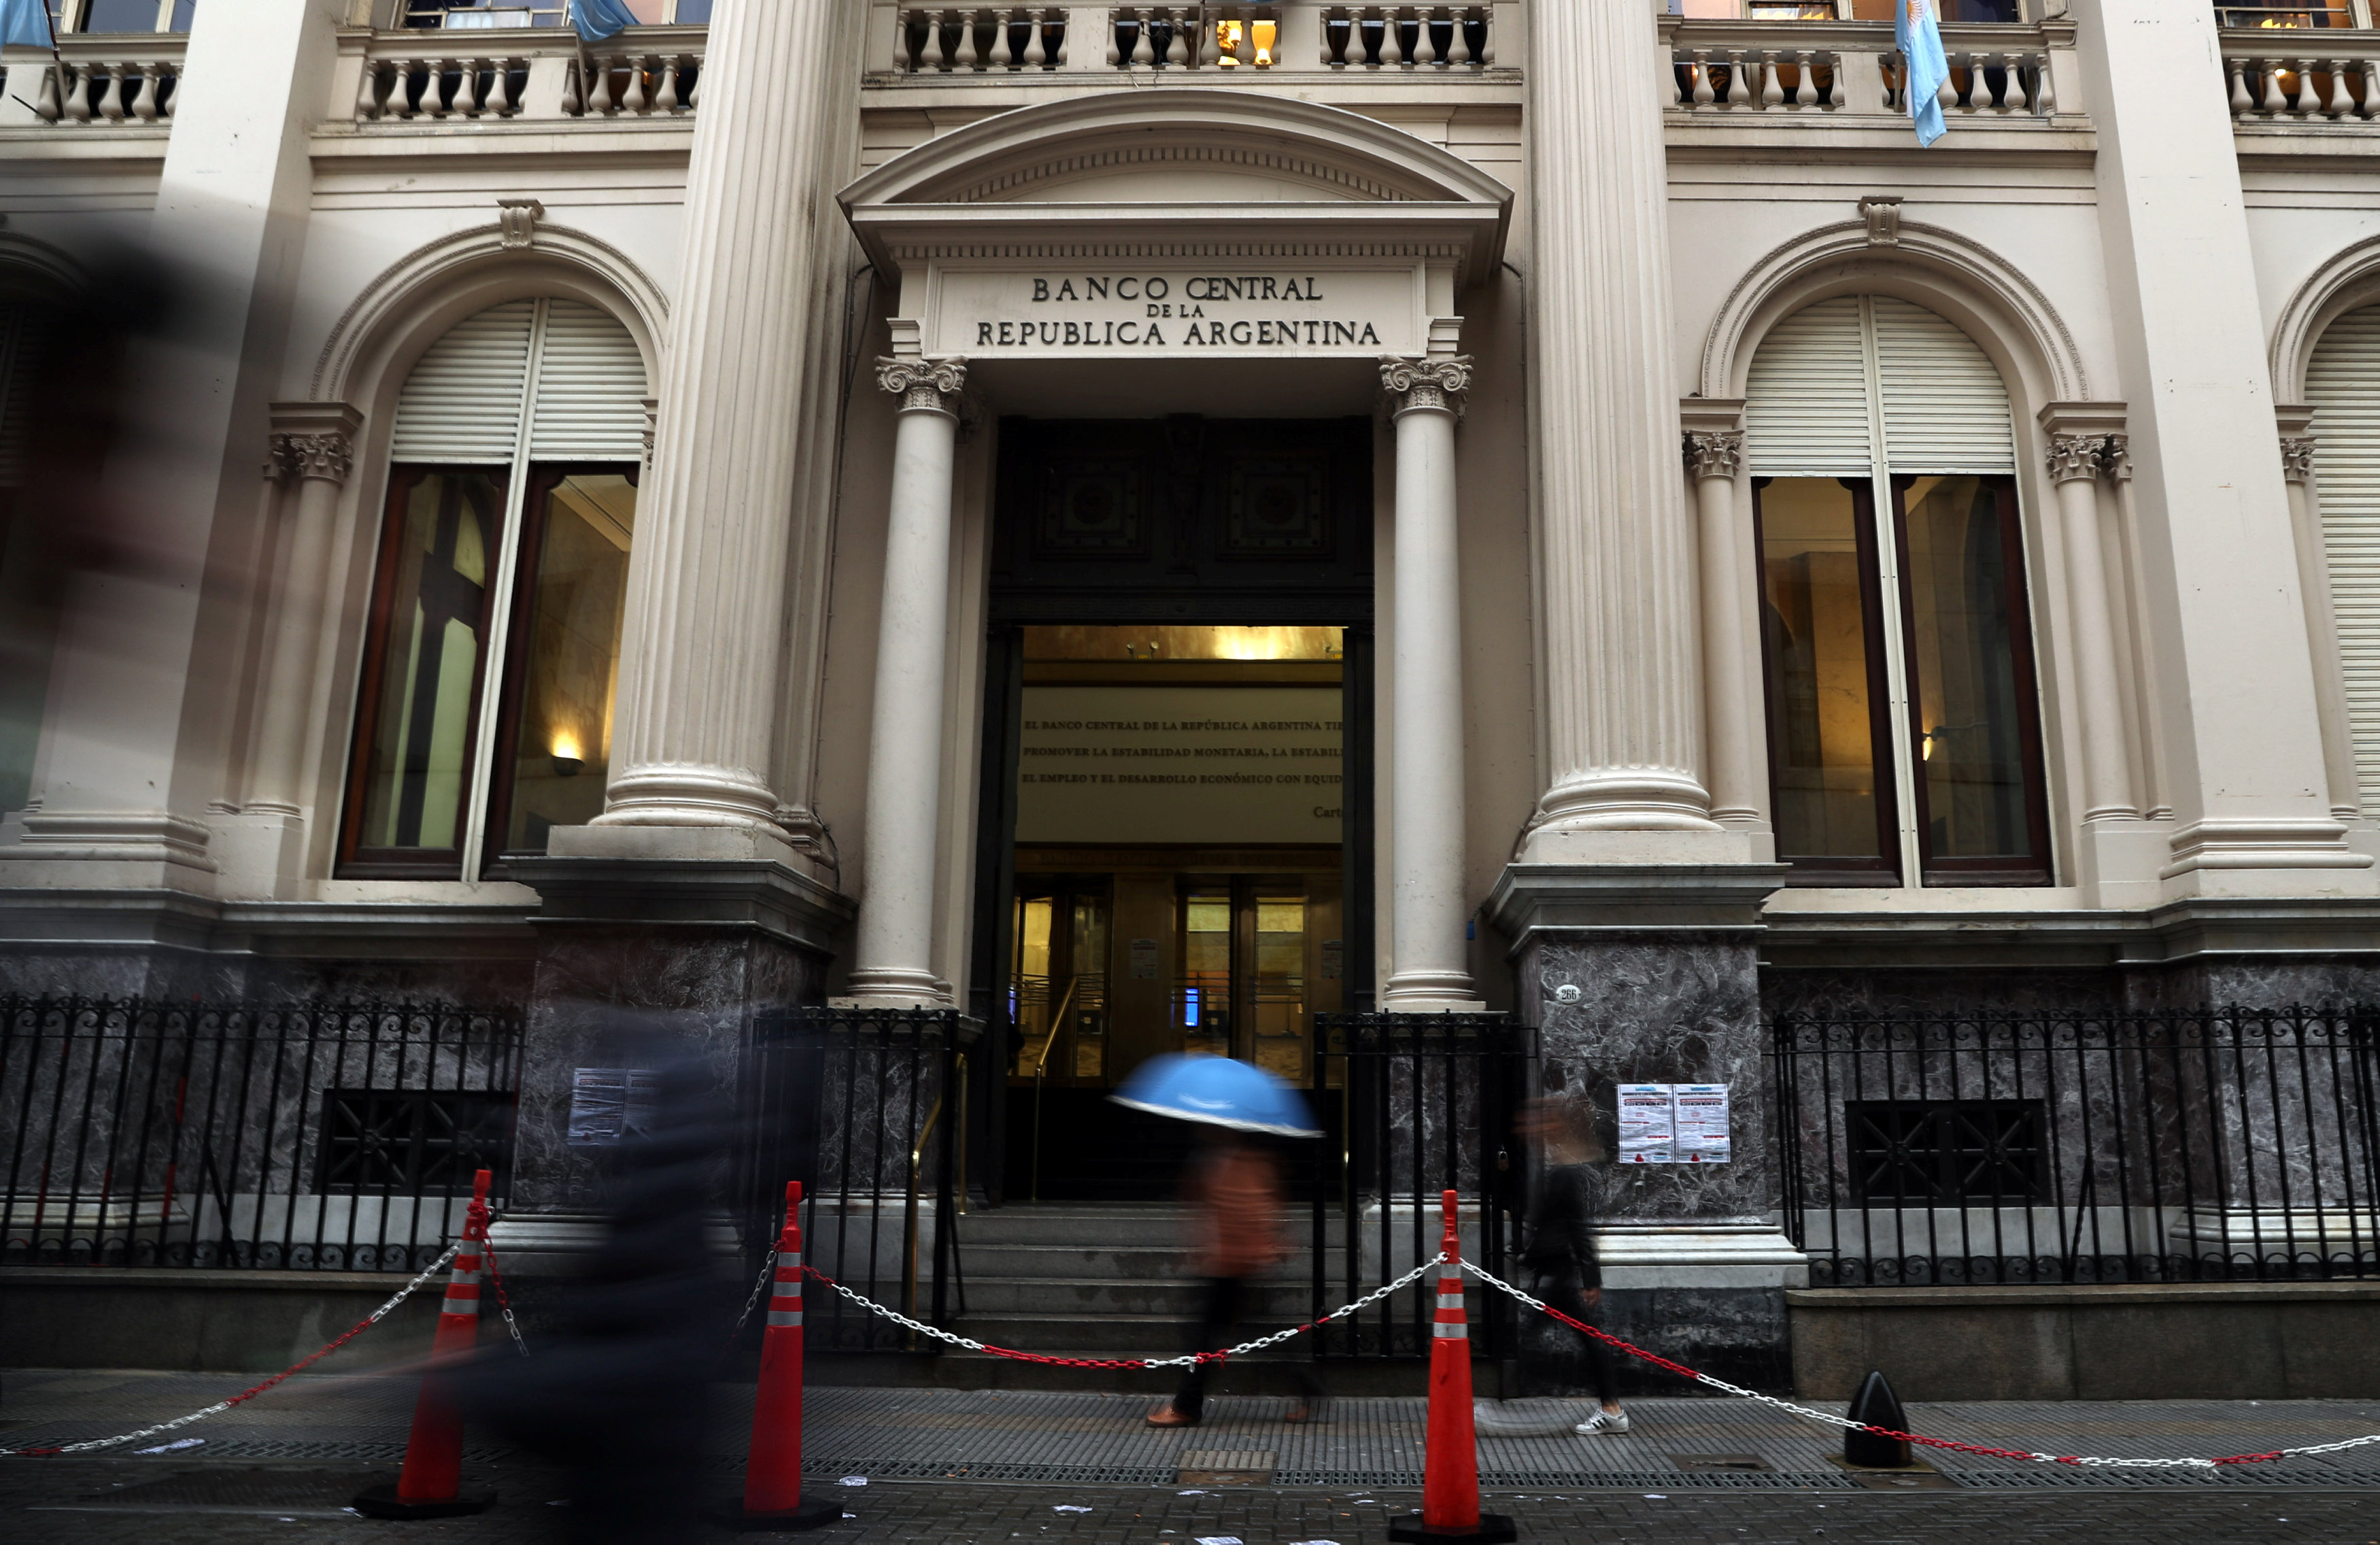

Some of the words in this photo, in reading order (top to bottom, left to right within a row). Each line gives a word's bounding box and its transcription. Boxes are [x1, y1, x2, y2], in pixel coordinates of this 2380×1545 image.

[1032, 276, 1168, 302] BANCO
[1185, 275, 1323, 301] CENTRAL
[1146, 303, 1171, 318] DE
[1180, 303, 1204, 318] LA
[976, 321, 1166, 345] REPUBLICA
[1183, 320, 1381, 345] ARGENTINA
[1024, 720, 1038, 730] EL
[1042, 721, 1083, 730] BANCO
[1085, 721, 1140, 731] CENTRAL
[1143, 721, 1159, 731] DE
[1162, 721, 1178, 731] LA
[1180, 719, 1248, 731] REPÚBLICA
[1251, 721, 1322, 731] ARGENTINA
[1023, 747, 1089, 757] PROMOVER
[1093, 747, 1108, 757] LA
[1111, 747, 1191, 758] ESTABILIDAD
[1193, 748, 1270, 759] MONETARIA,
[1272, 748, 1288, 758] LA
[1022, 774, 1037, 783] EL
[1040, 774, 1088, 783] EMPLEO
[1090, 774, 1099, 783] Y
[1101, 774, 1116, 783] EL
[1119, 775, 1197, 784] DESARROLLO
[1200, 772, 1274, 784] ECONÓMICO
[1276, 774, 1302, 784] CON
[1313, 805, 1343, 819] Cart
[1561, 989, 1577, 1000] 266
